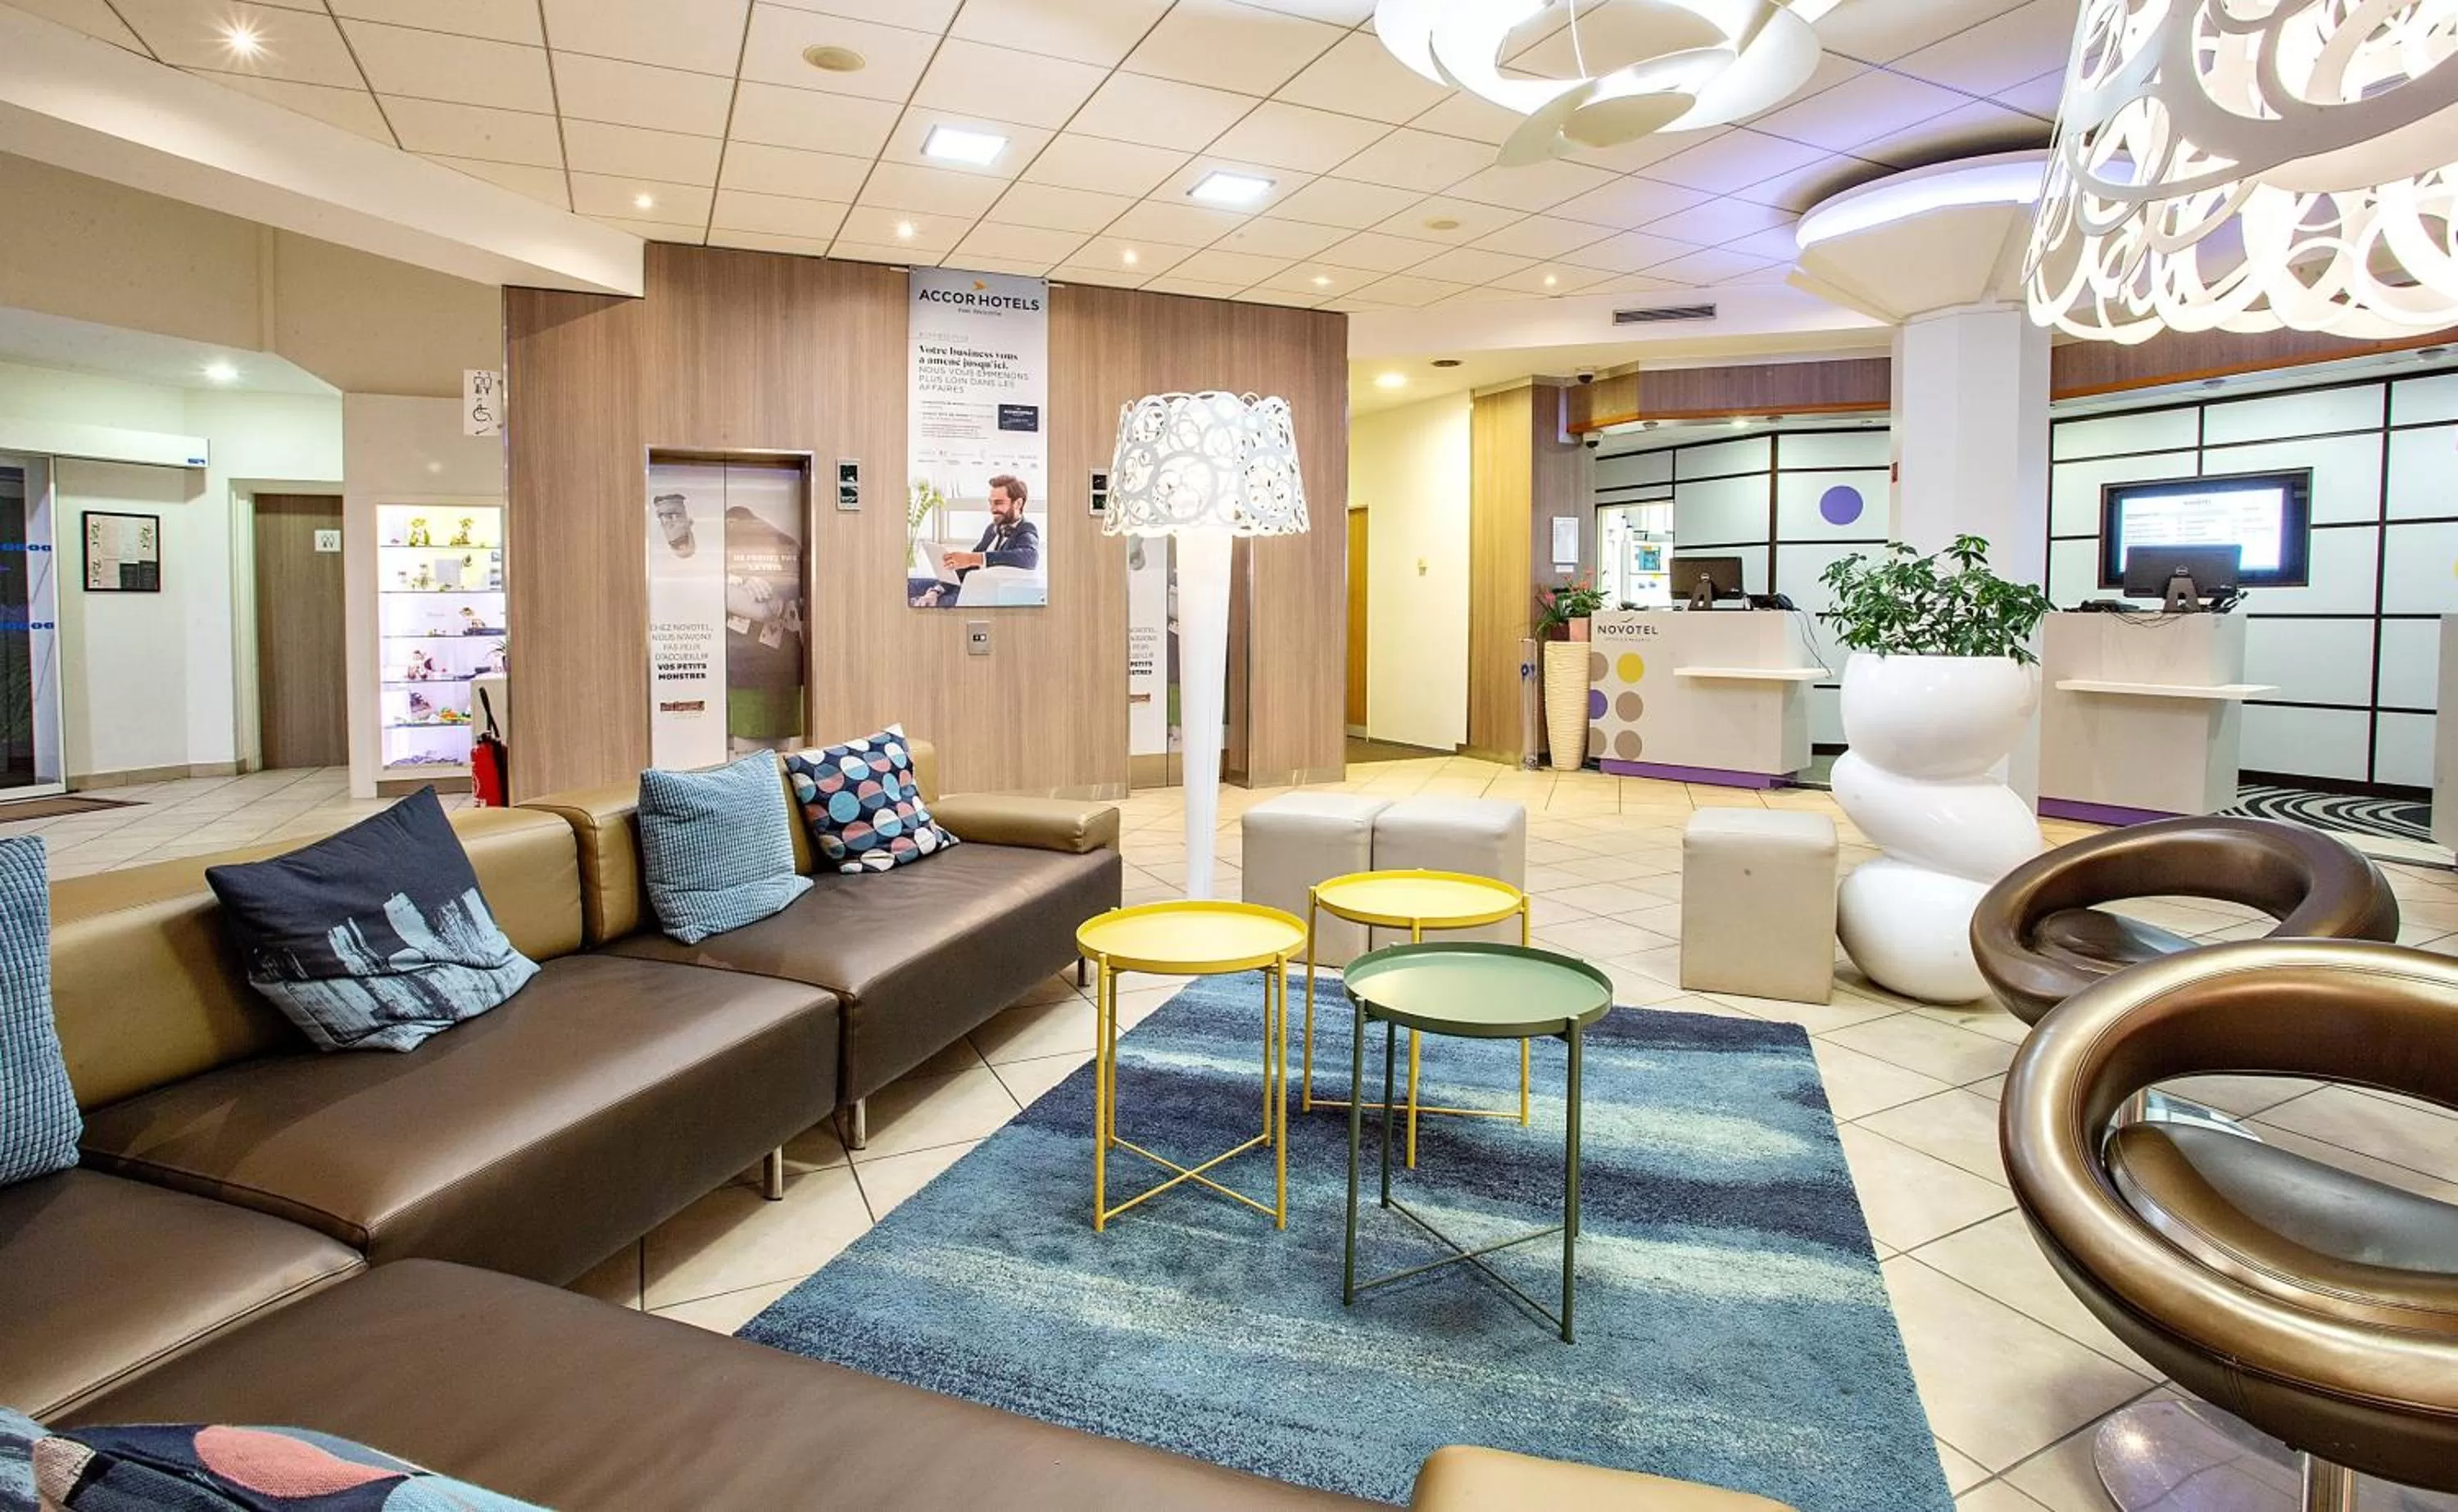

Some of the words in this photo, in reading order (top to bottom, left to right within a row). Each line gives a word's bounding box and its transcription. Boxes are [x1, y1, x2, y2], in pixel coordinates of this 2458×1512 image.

[919, 345, 947, 355] Votre
[950, 346, 993, 358] business
[918, 366, 946, 374] NOUS
[918, 374, 943, 383] PLUS
[945, 376, 968, 385] LOIN
[1597, 625, 1658, 635] NOVOTEL
[658, 672, 706, 681] MONSTRES
